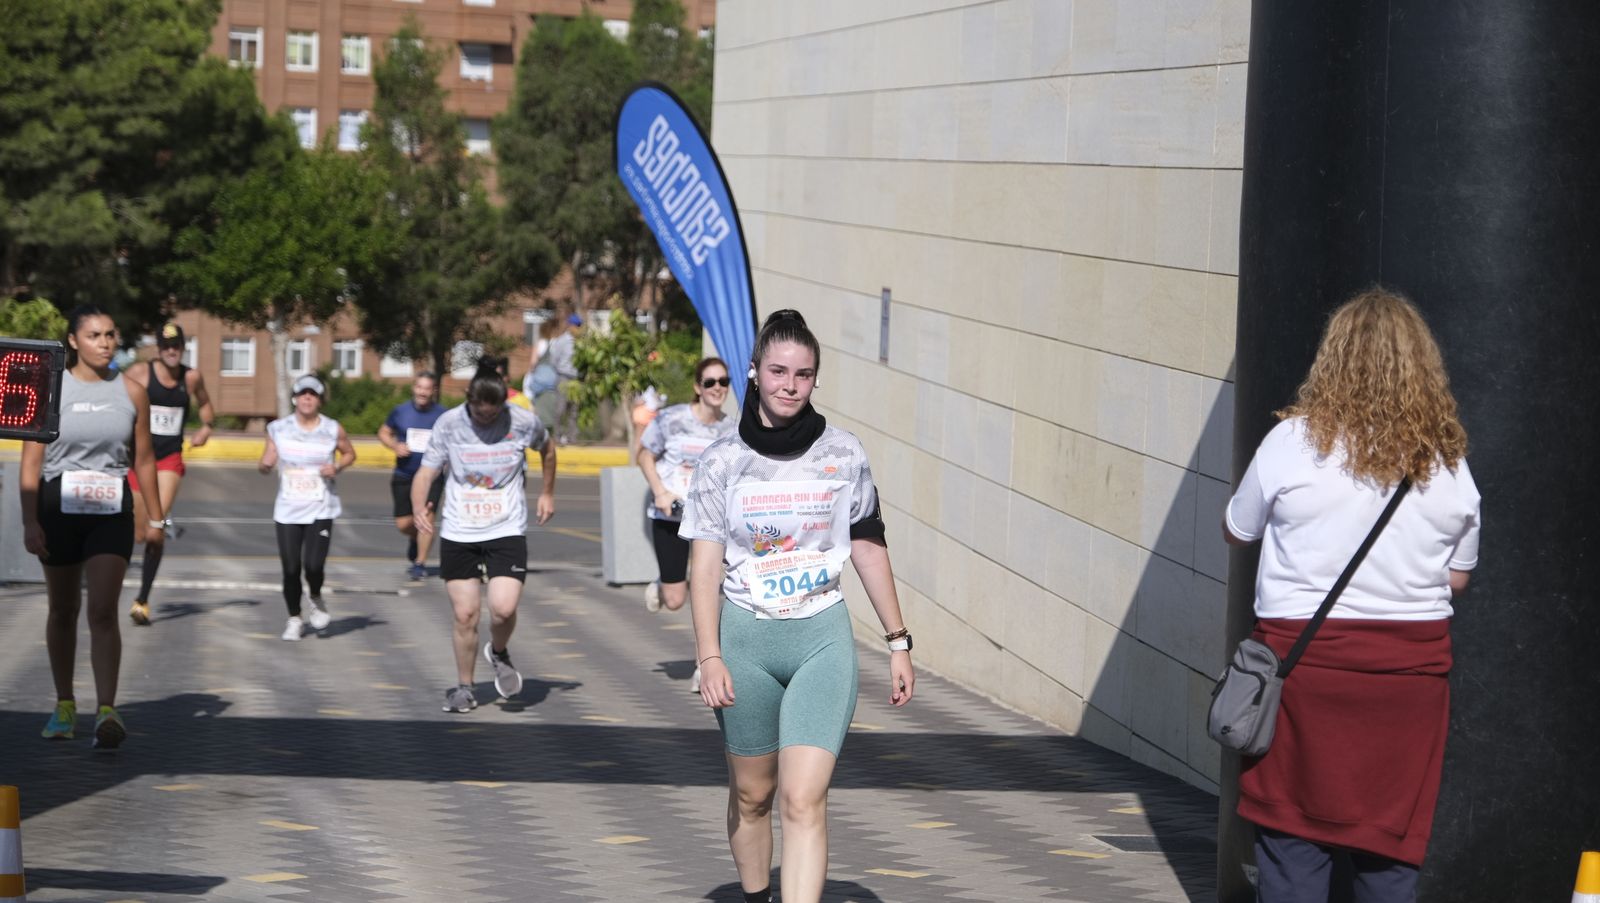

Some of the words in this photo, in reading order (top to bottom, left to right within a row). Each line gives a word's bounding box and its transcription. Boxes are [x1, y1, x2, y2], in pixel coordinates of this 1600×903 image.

[72, 486, 117, 501] 1265
[750, 494, 792, 505] CARRERA
[463, 503, 502, 515] 1199
[761, 557, 792, 569] CARRERA
[762, 568, 831, 599] 2044
